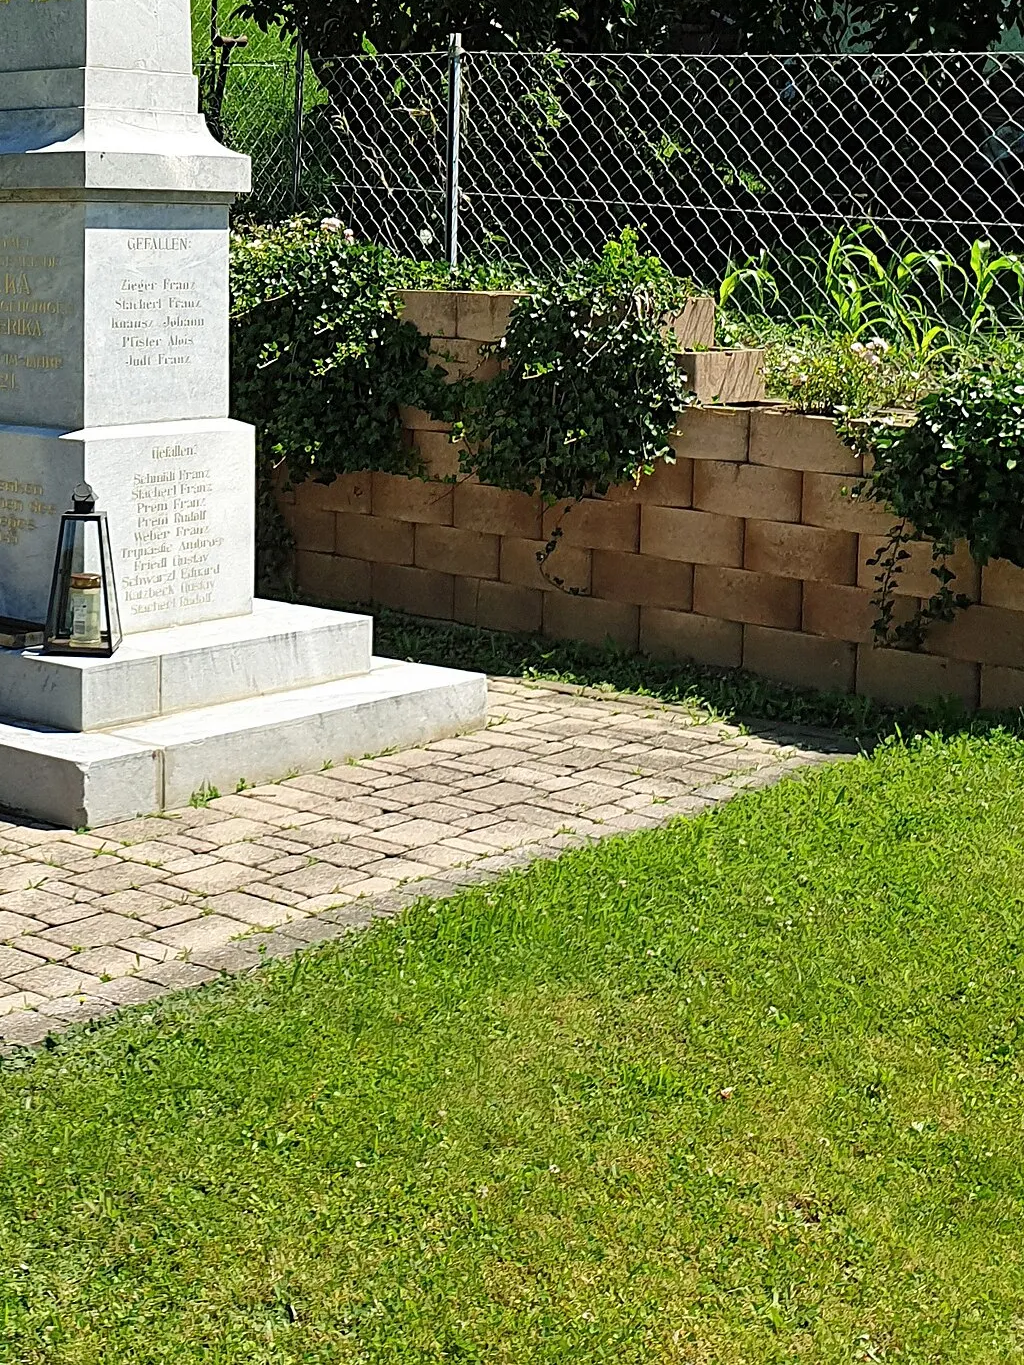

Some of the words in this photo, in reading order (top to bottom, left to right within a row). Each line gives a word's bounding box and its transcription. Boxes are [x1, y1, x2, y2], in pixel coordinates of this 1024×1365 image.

[127, 237, 192, 250] GEFALLEN:
[163, 278, 196, 291] Franz
[168, 296, 203, 309] Franz
[163, 315, 205, 328] Johann
[122, 336, 163, 348] Pfister
[168, 334, 195, 347] Alois
[158, 353, 192, 365] Franz
[178, 469, 211, 481] Franz
[180, 483, 213, 495] Franz
[136, 502, 168, 514] Prem
[173, 498, 207, 510] Franz
[137, 516, 169, 528] Prem
[174, 510, 207, 524] Rudolf
[133, 530, 170, 543] Weber
[176, 525, 209, 537] Franz
[172, 553, 210, 567] Gustav
[180, 564, 220, 579] Eduard
[180, 580, 216, 594] Gustav
